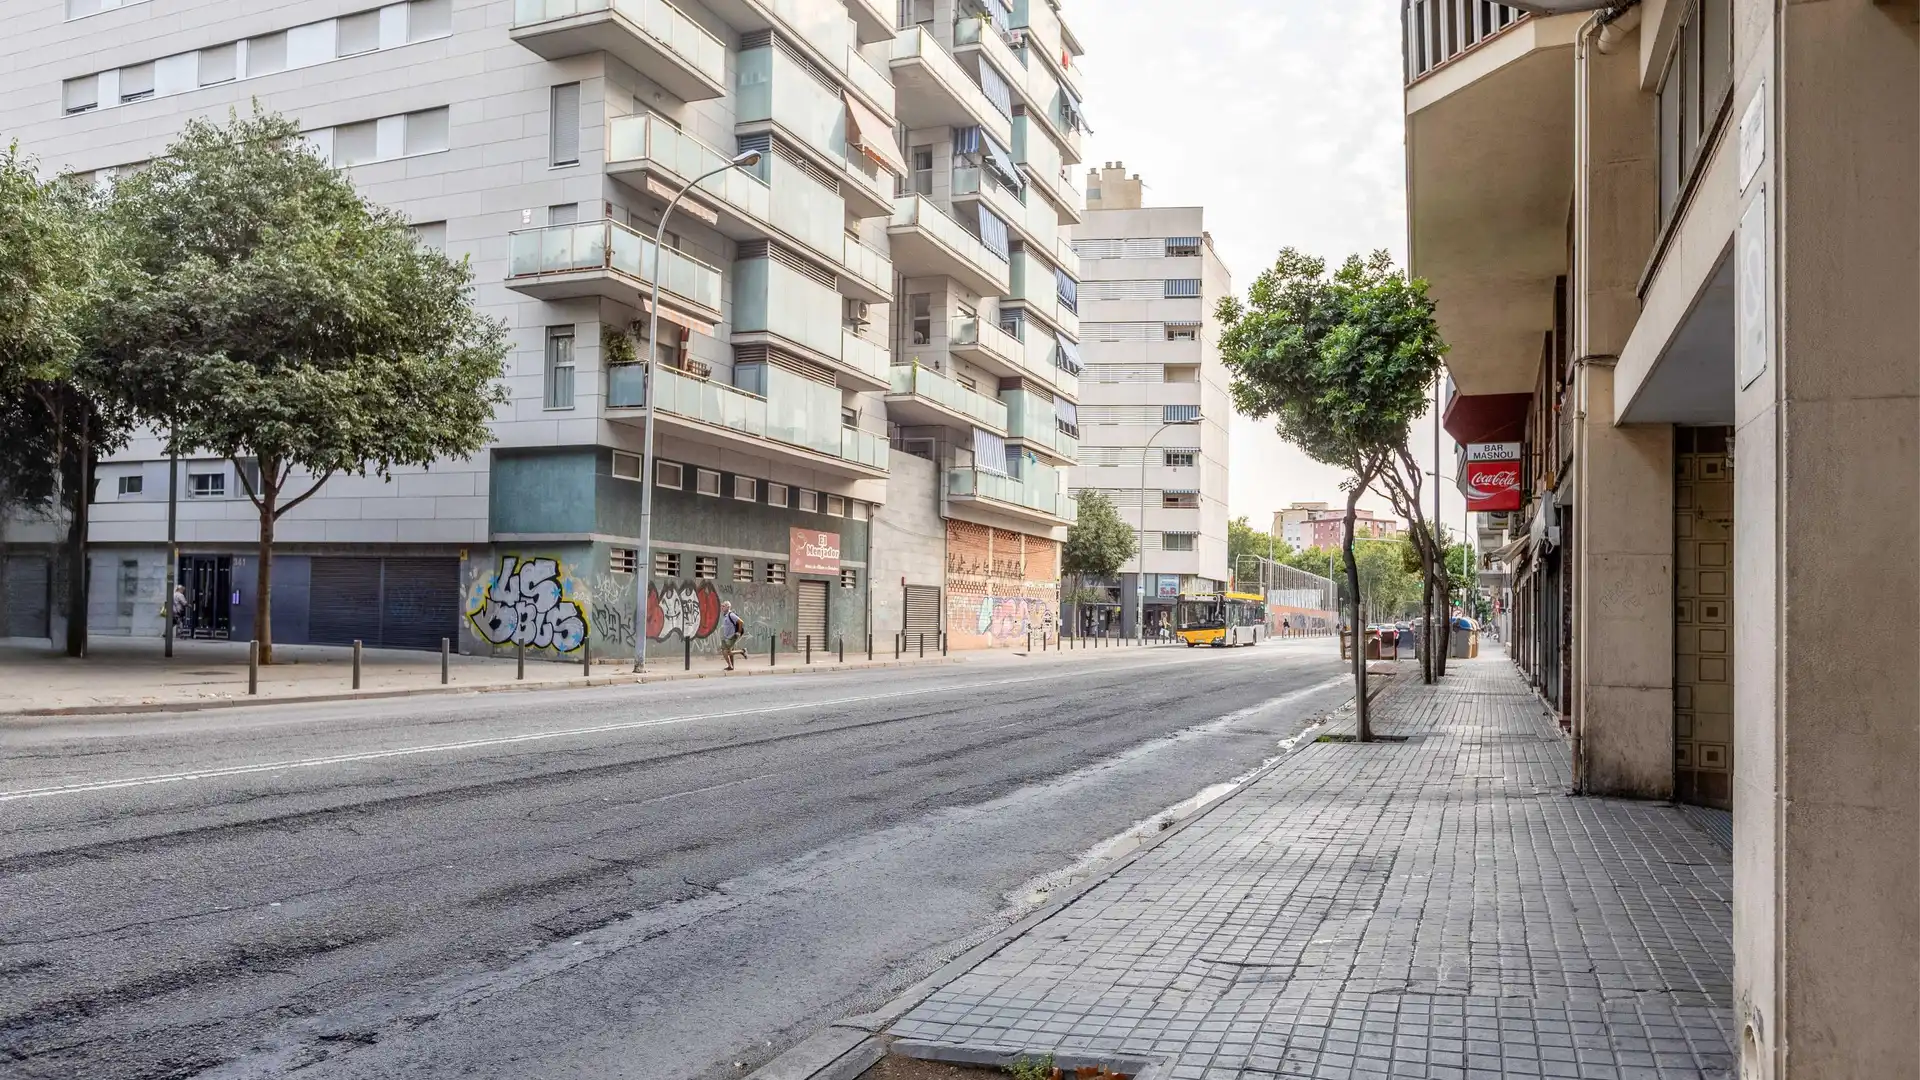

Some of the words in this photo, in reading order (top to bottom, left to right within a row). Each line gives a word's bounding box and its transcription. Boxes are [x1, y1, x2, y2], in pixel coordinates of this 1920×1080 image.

[1484, 444, 1504, 452] BAR
[1473, 451, 1514, 459] MASNOU
[1472, 471, 1517, 486] Coca-Cola
[806, 543, 840, 559] Menjador
